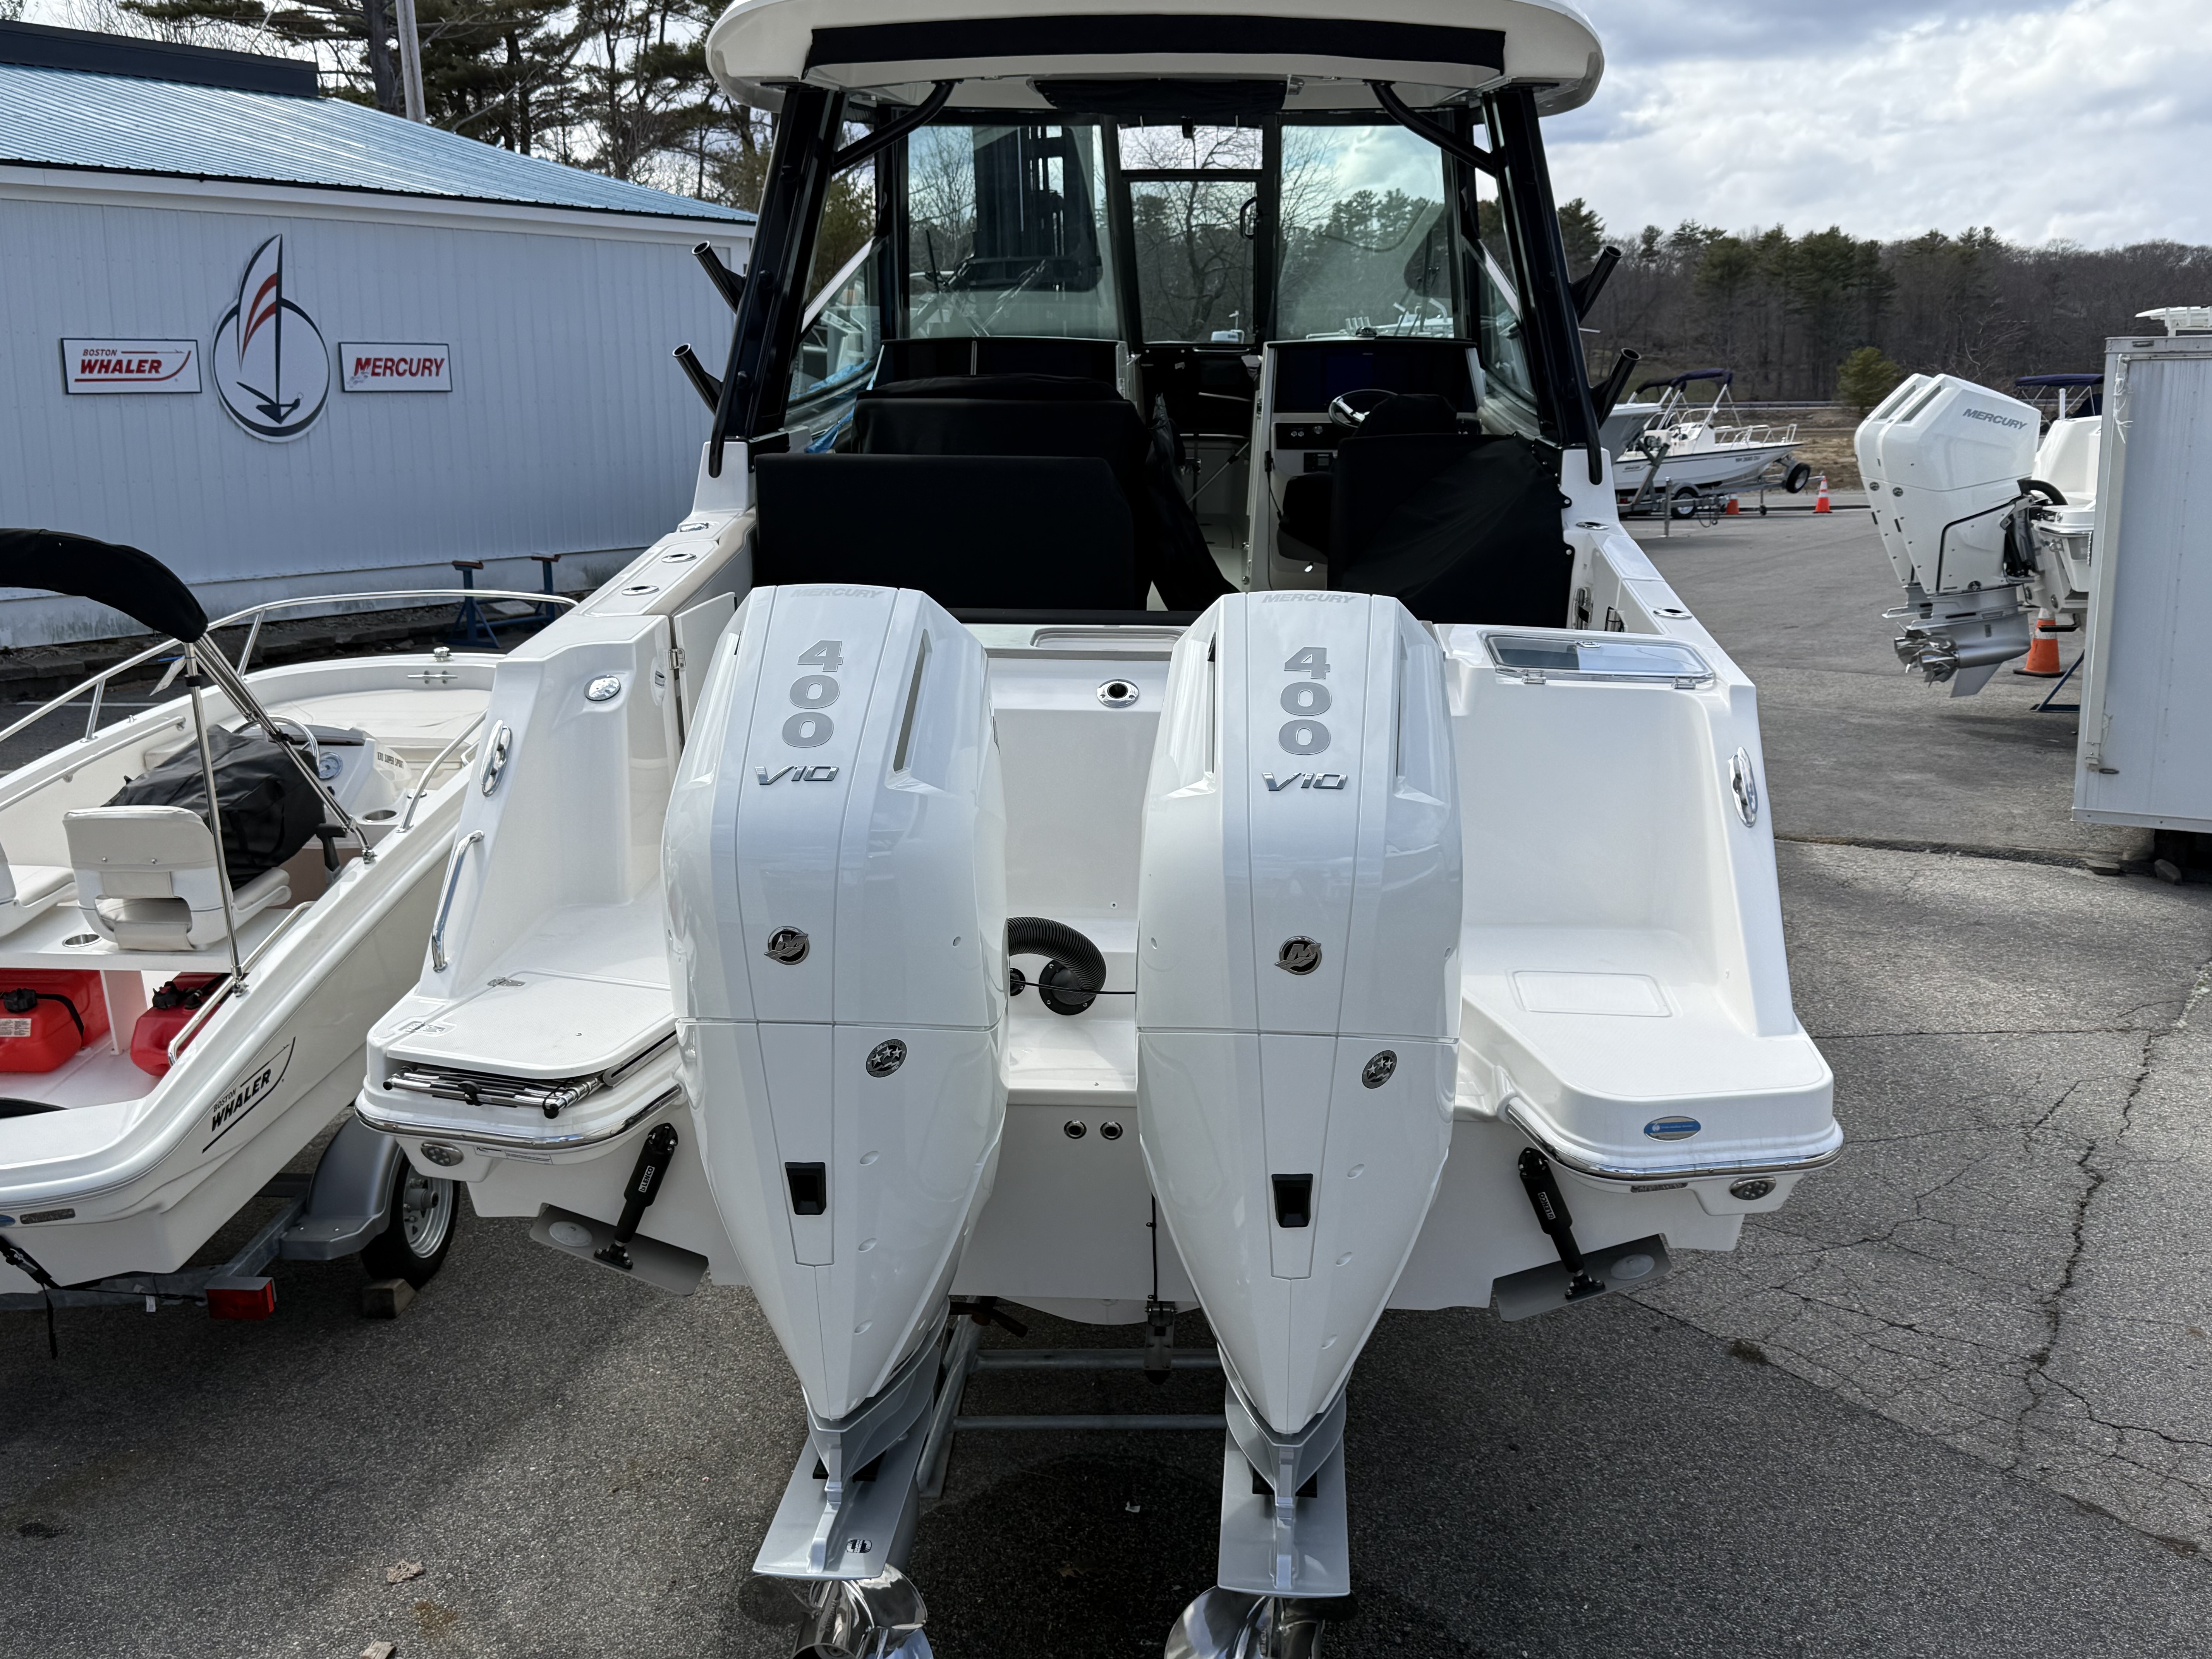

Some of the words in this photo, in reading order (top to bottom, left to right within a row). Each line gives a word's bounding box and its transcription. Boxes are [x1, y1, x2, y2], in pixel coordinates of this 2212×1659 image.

[81, 359, 162, 374] WHALER
[354, 357, 445, 377] MERCURY
[1963, 409, 2028, 429] MERCURY
[790, 588, 885, 598] MERCURY
[1262, 593, 1357, 603] MERCURY
[782, 640, 843, 748] 400
[1278, 646, 1331, 755] 400
[754, 765, 840, 785] V10
[1262, 772, 1348, 791] V10
[212, 1068, 271, 1132] WHALER
[213, 1087, 237, 1113] BOSTON
